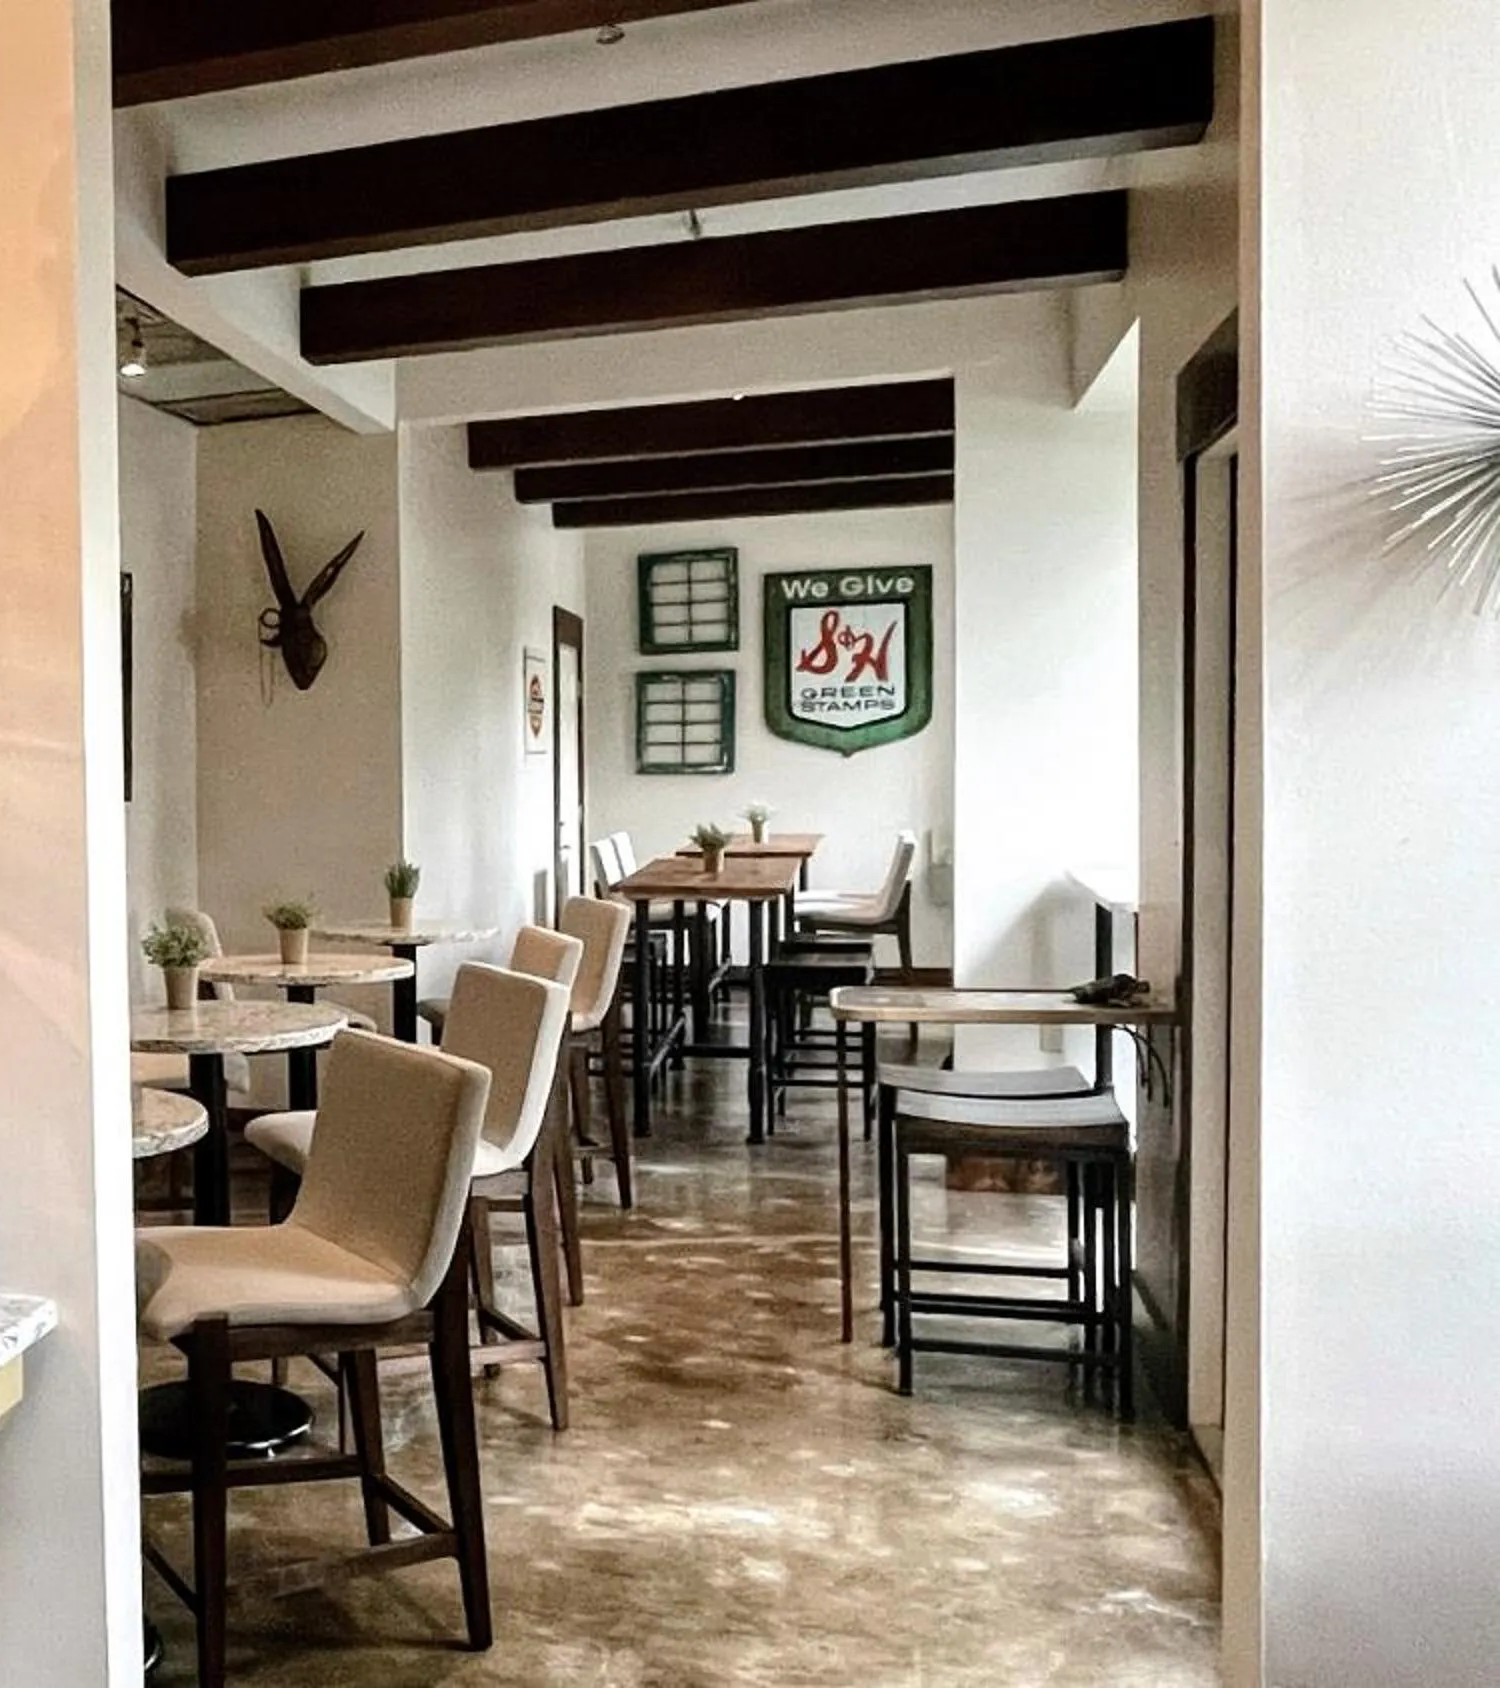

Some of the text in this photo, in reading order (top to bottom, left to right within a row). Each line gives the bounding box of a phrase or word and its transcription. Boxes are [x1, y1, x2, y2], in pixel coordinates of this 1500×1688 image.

[781, 578, 829, 600] We
[800, 685, 896, 700] GREEN
[800, 699, 896, 714] STAMPS
